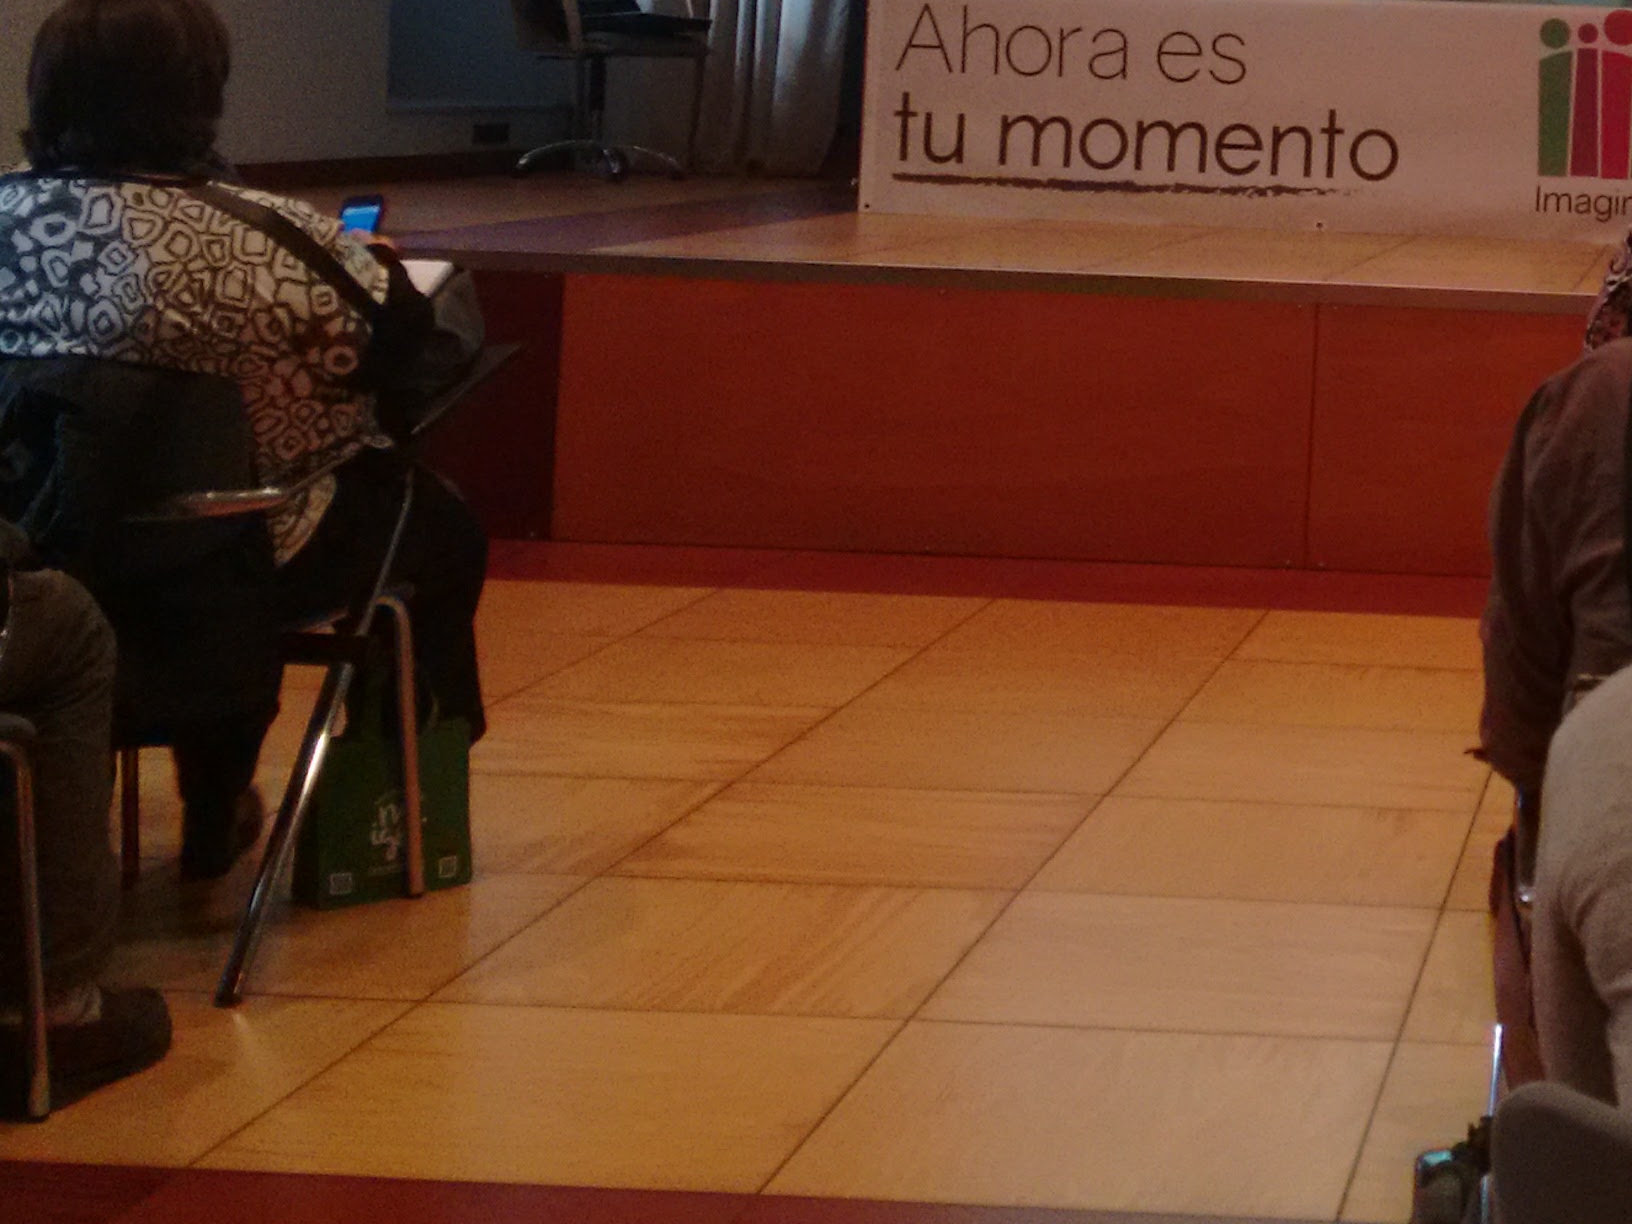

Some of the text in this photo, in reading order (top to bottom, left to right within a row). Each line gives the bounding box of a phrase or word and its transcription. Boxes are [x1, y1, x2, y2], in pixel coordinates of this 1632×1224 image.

[895, 3, 1247, 85] Ahora es
[893, 93, 1401, 182] tu momento
